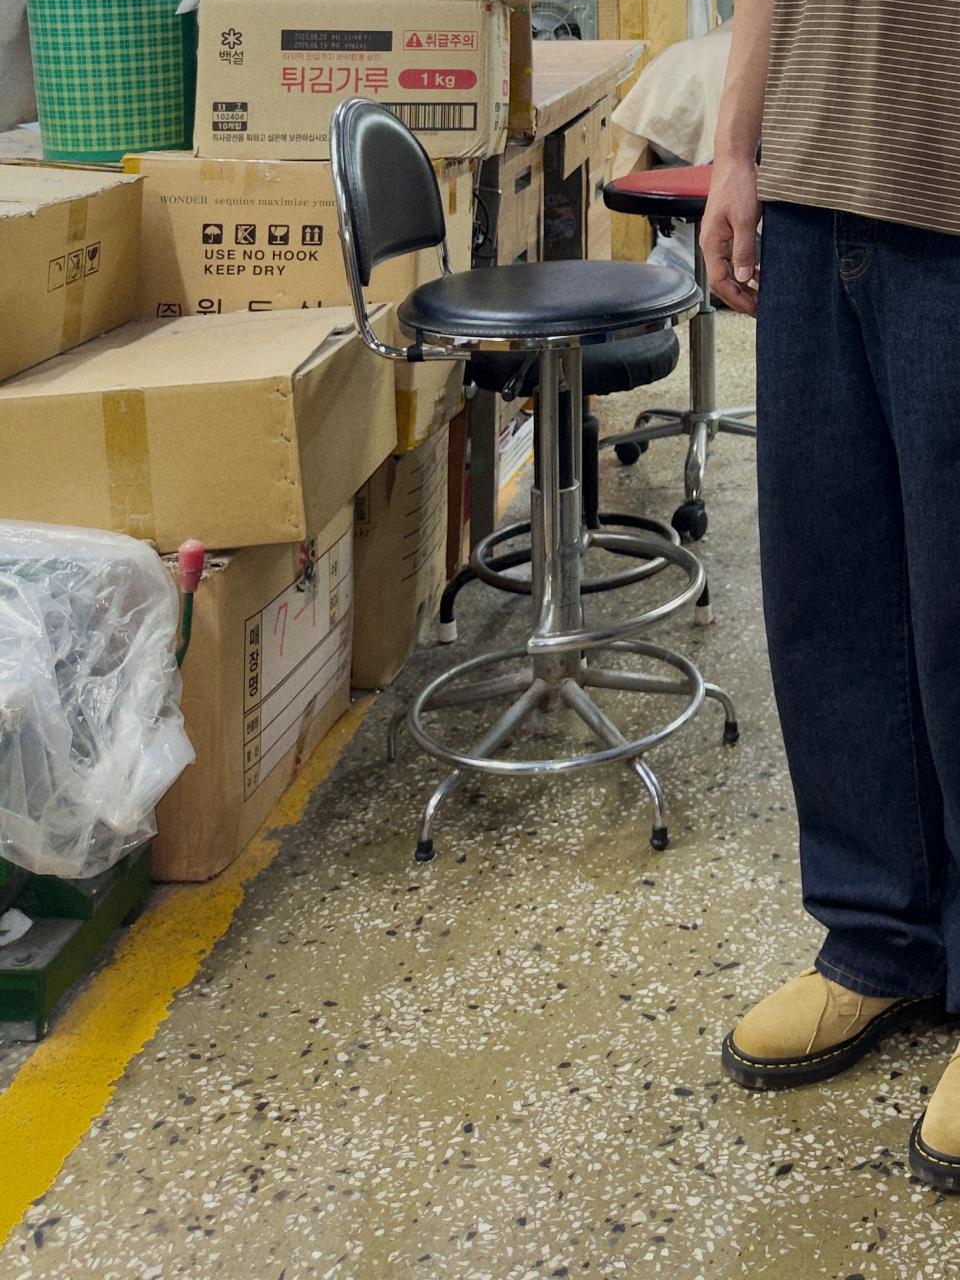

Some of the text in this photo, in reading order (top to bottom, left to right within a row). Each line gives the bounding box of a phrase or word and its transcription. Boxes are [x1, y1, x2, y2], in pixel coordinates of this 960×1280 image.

[425, 33, 474, 48] 취급주의
[218, 50, 244, 65] 백설
[281, 67, 389, 94] 튀김가루
[421, 72, 456, 89] 1 kg
[160, 195, 208, 205] WONDER
[258, 198, 309, 207] maximize
[204, 249, 319, 261] USE NO HOOK
[204, 264, 286, 276] KEEP DRY
[248, 623, 260, 697] 매장명
